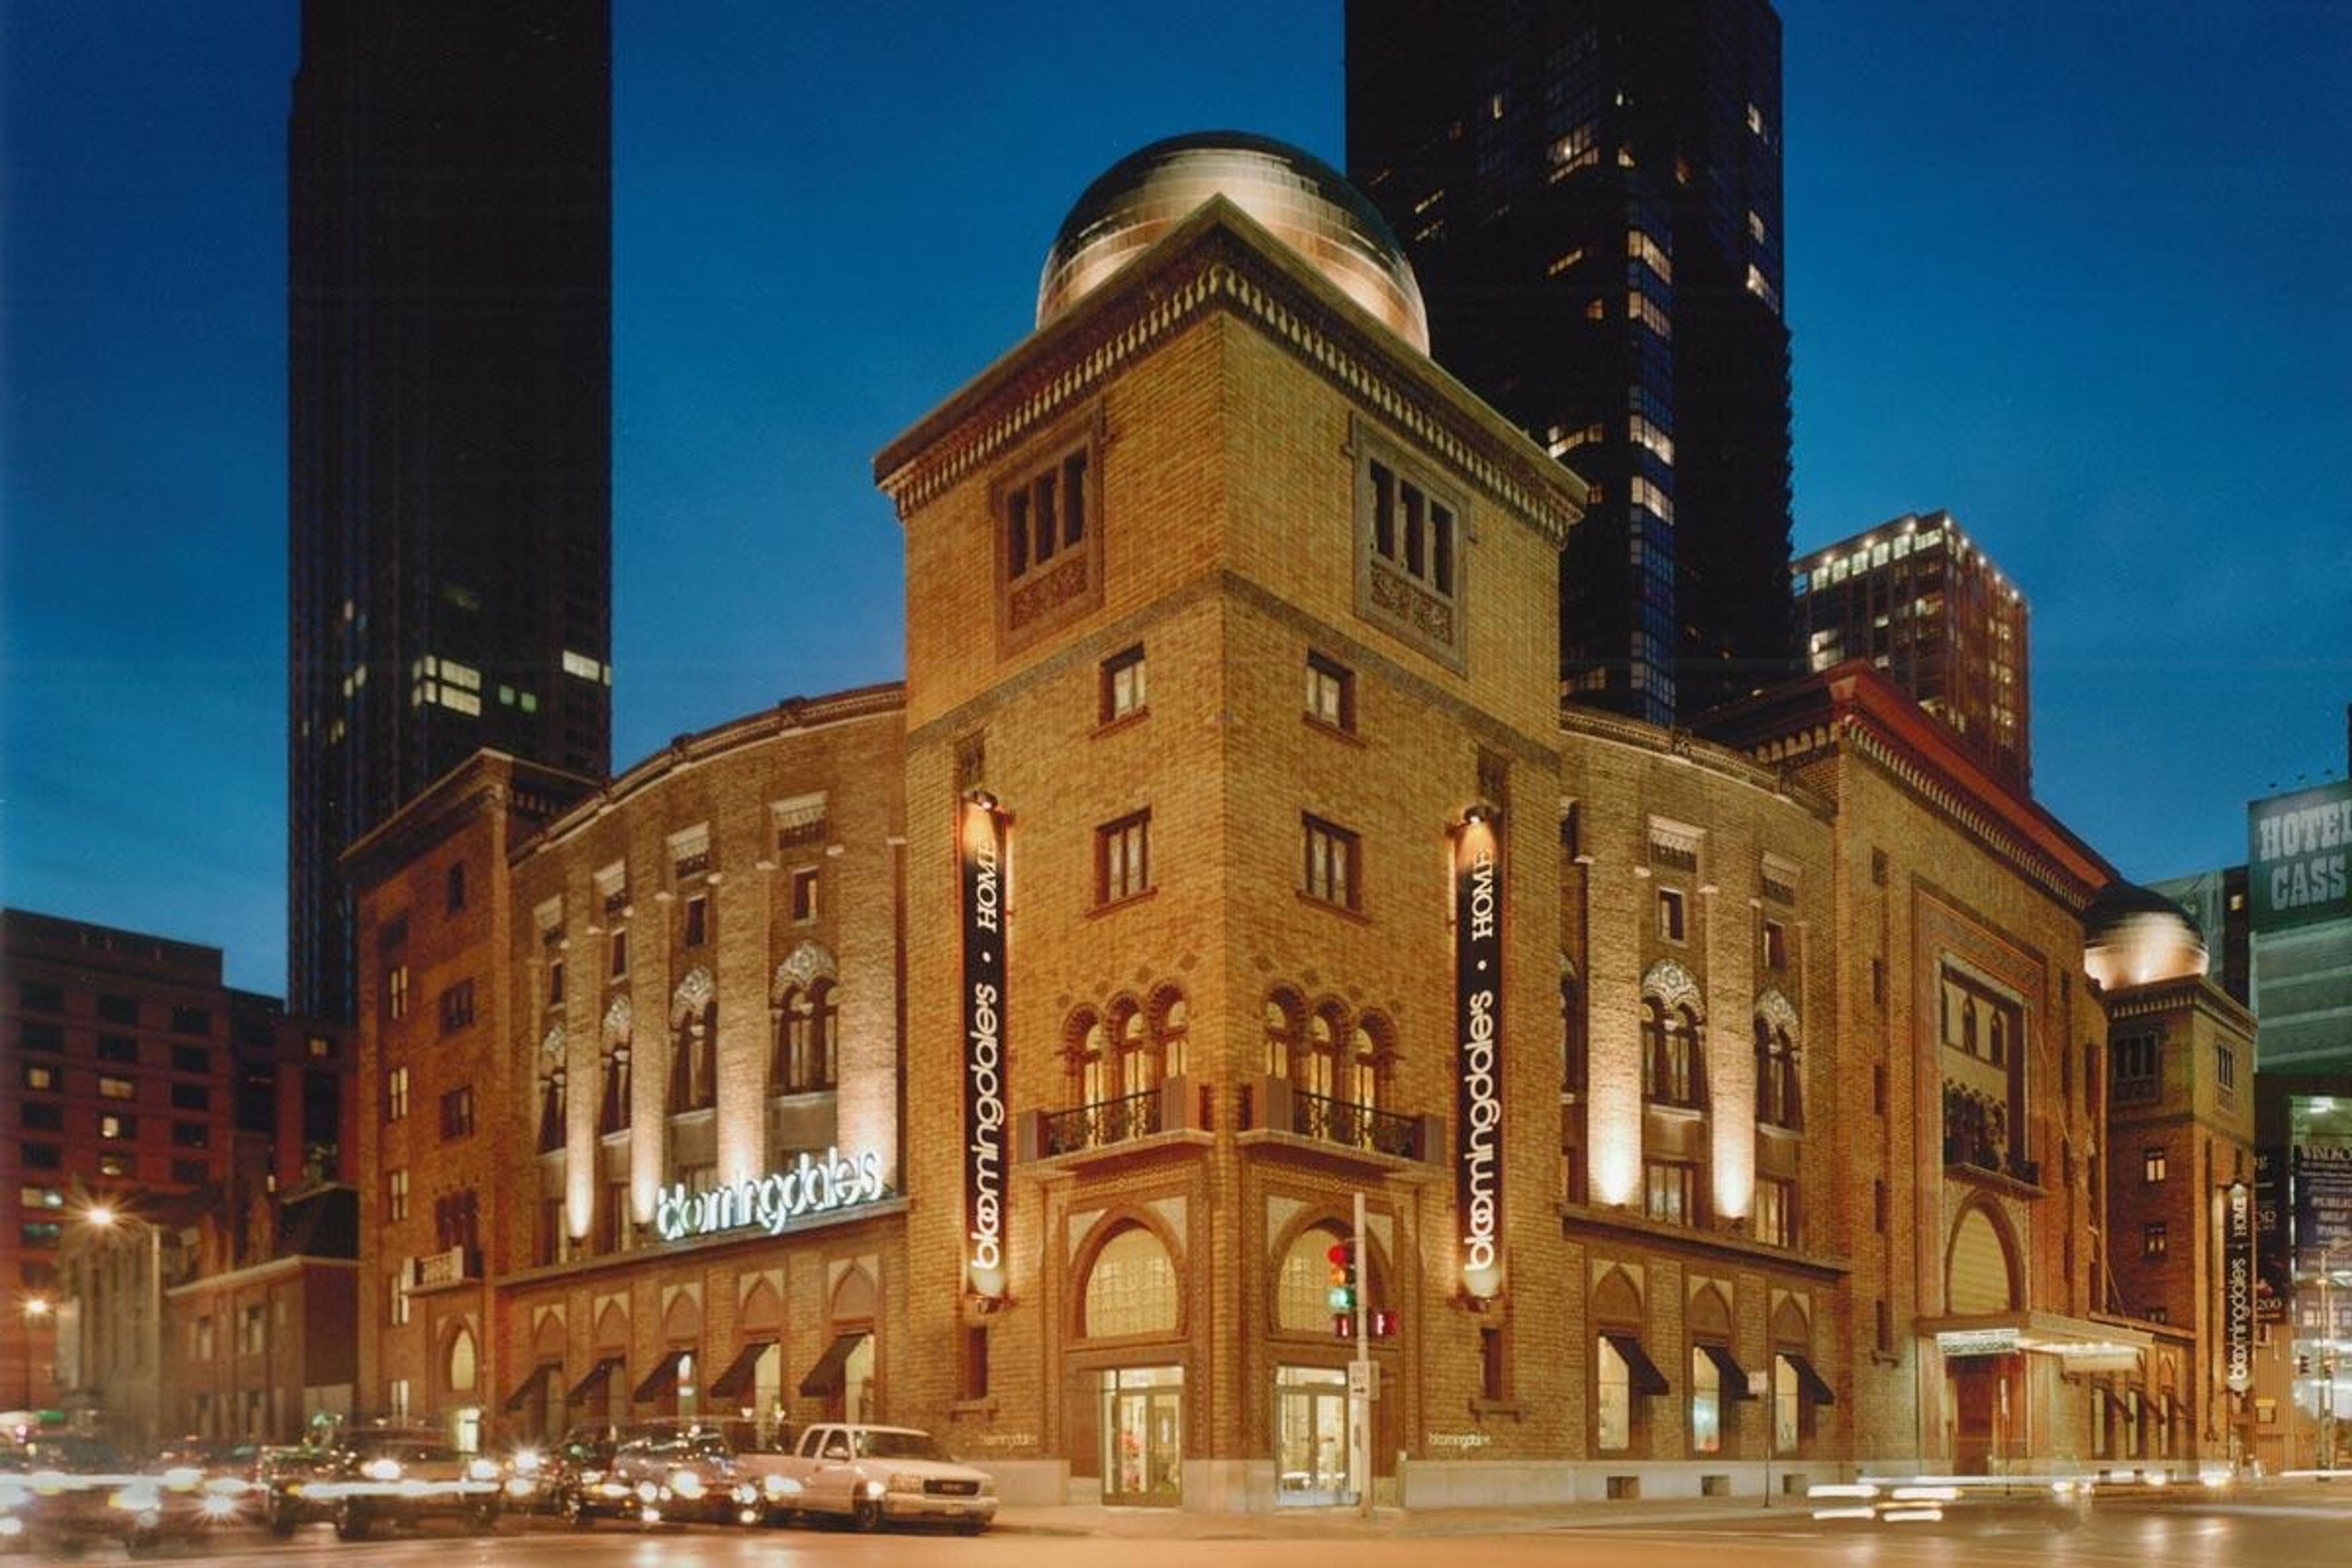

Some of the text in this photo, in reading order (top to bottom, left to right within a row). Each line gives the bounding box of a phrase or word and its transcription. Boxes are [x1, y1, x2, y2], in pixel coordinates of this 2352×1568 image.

[2260, 799, 2352, 862] HOTEL
[1471, 848, 1493, 941] HOME
[2271, 853, 2347, 911] CASS
